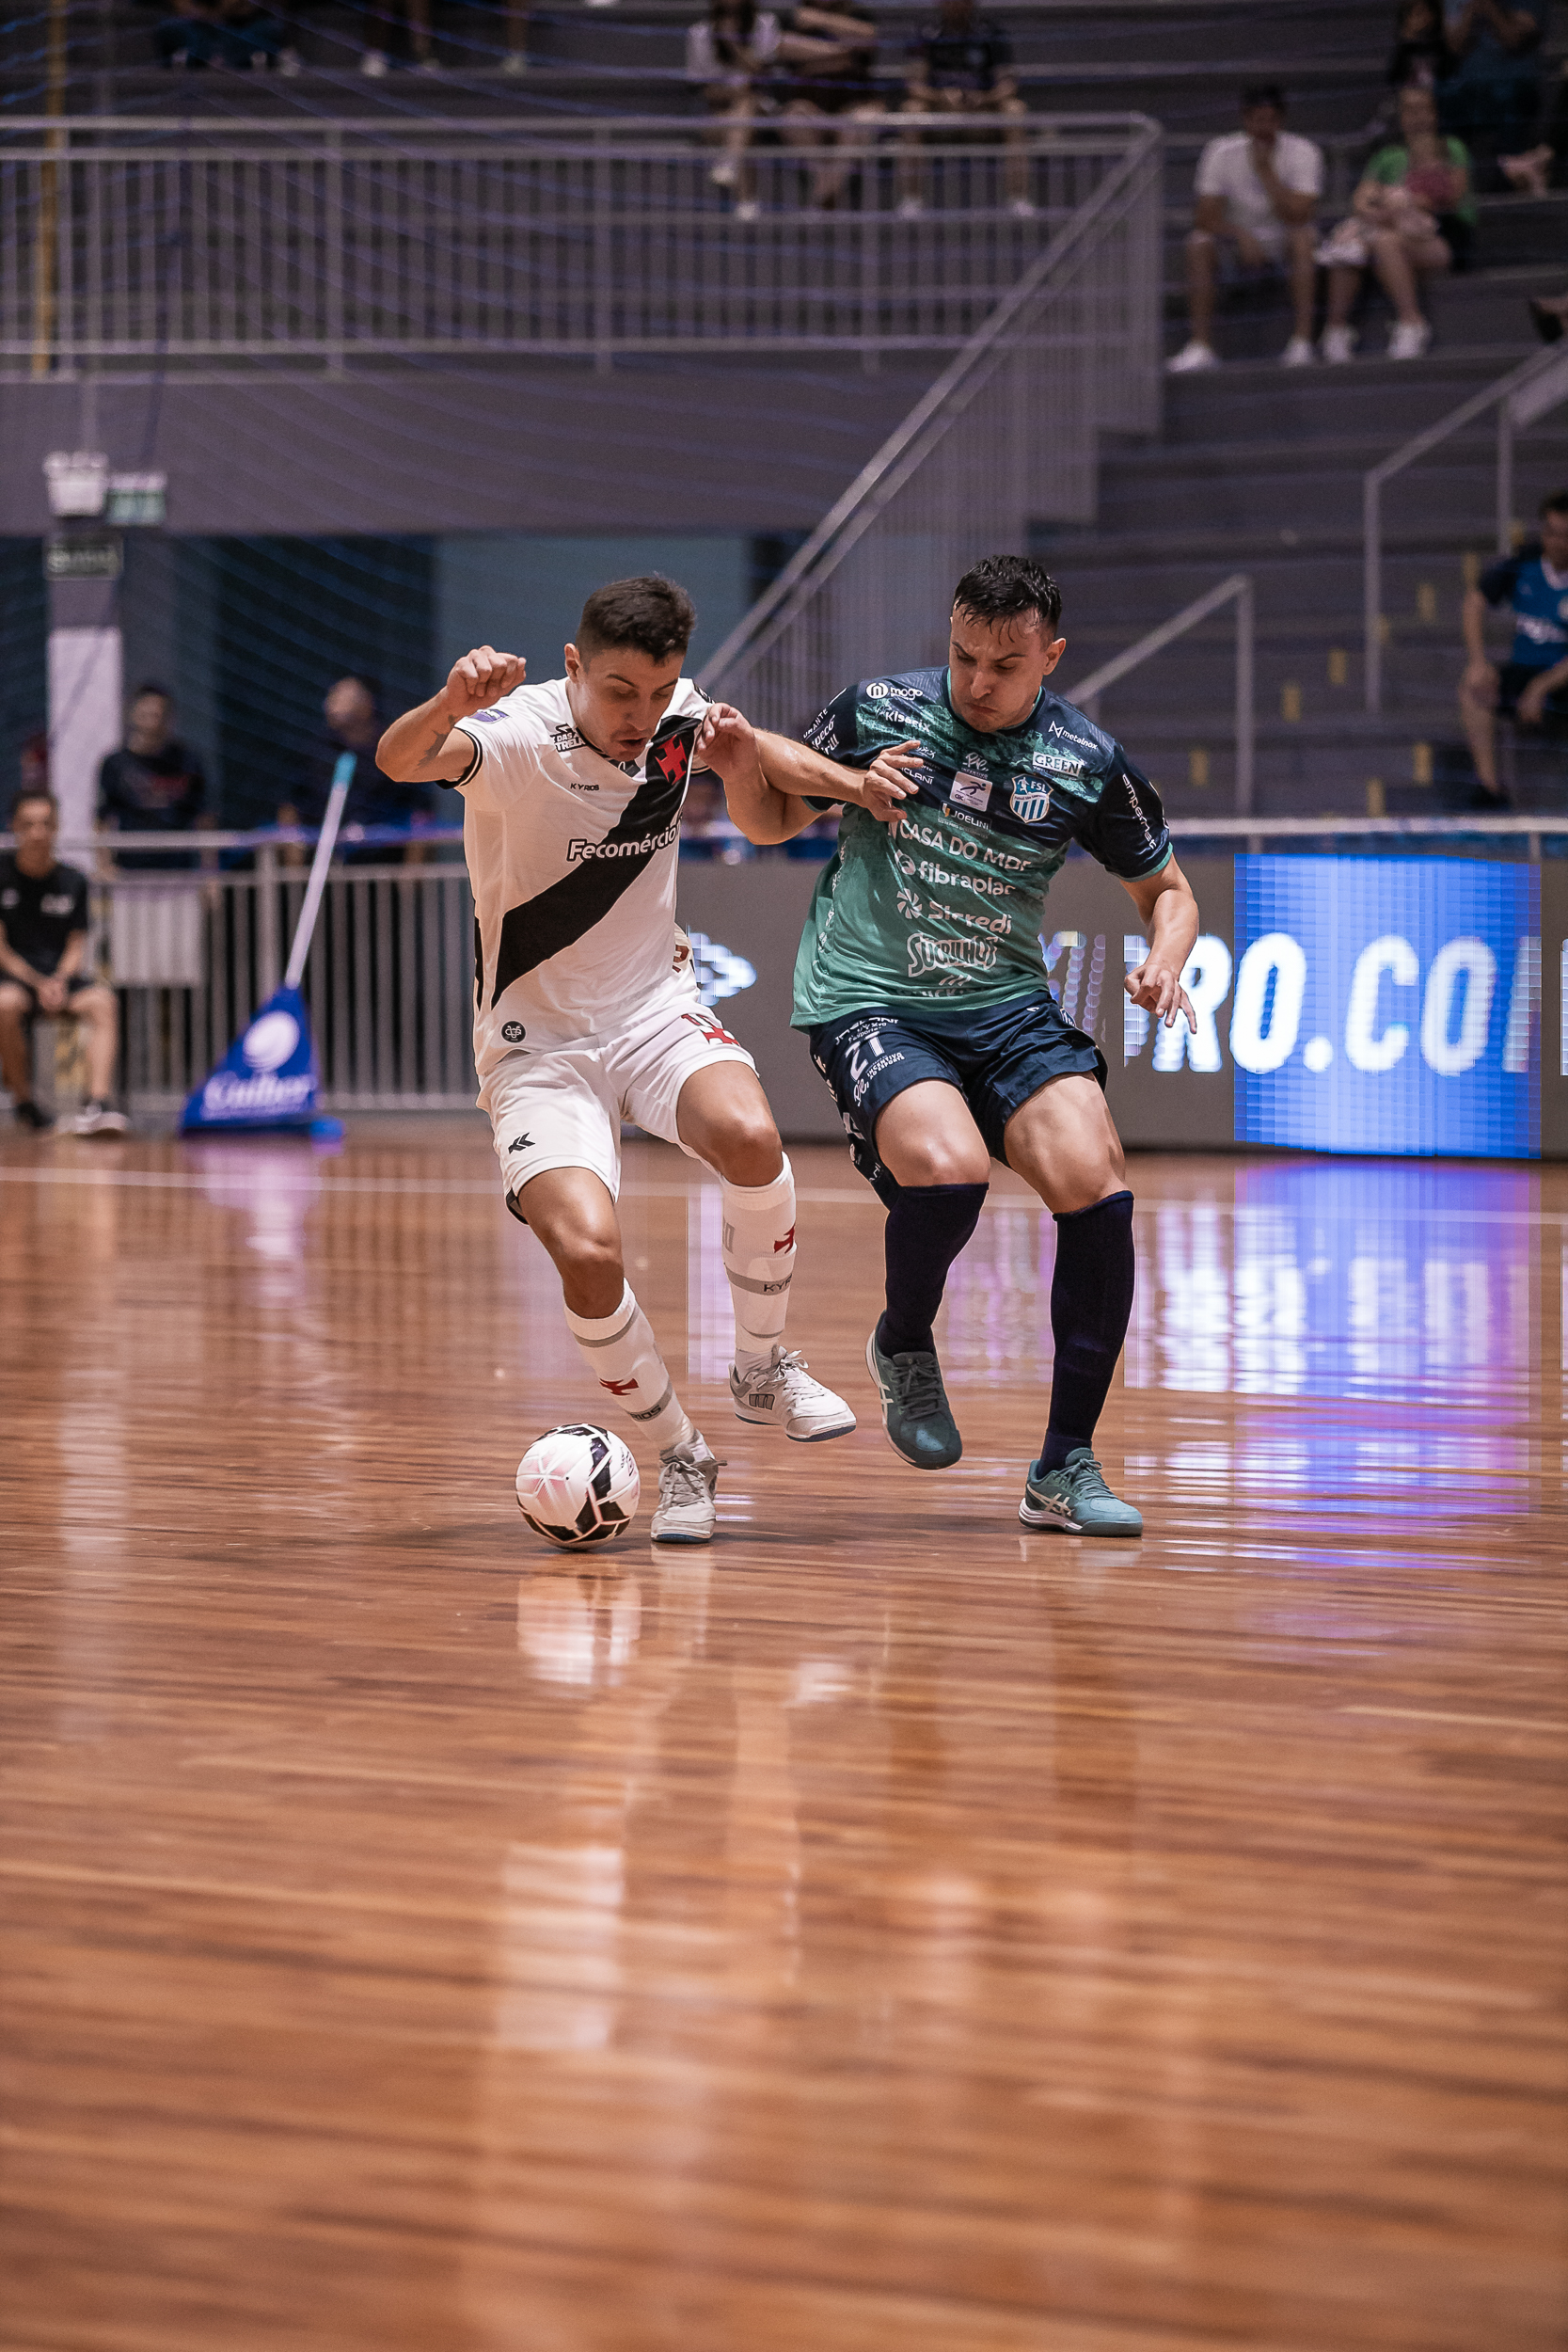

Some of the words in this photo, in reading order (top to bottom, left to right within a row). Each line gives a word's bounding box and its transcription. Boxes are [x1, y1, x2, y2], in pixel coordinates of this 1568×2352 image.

[891, 687, 923, 701] mogo
[821, 734, 840, 755] rill
[1062, 729, 1099, 750] metalnox
[1035, 754, 1080, 775] GREEN
[902, 767, 934, 785] CLANI
[1031, 781, 1047, 793] FSL
[950, 811, 990, 830] JOELINI
[567, 825, 677, 861] Fecomércio
[899, 818, 944, 850] CASA
[949, 836, 978, 860] DO
[845, 1031, 885, 1082] 21
[866, 1052, 904, 1077] INCENTIVO
[878, 1055, 906, 1072] ESPORTE
